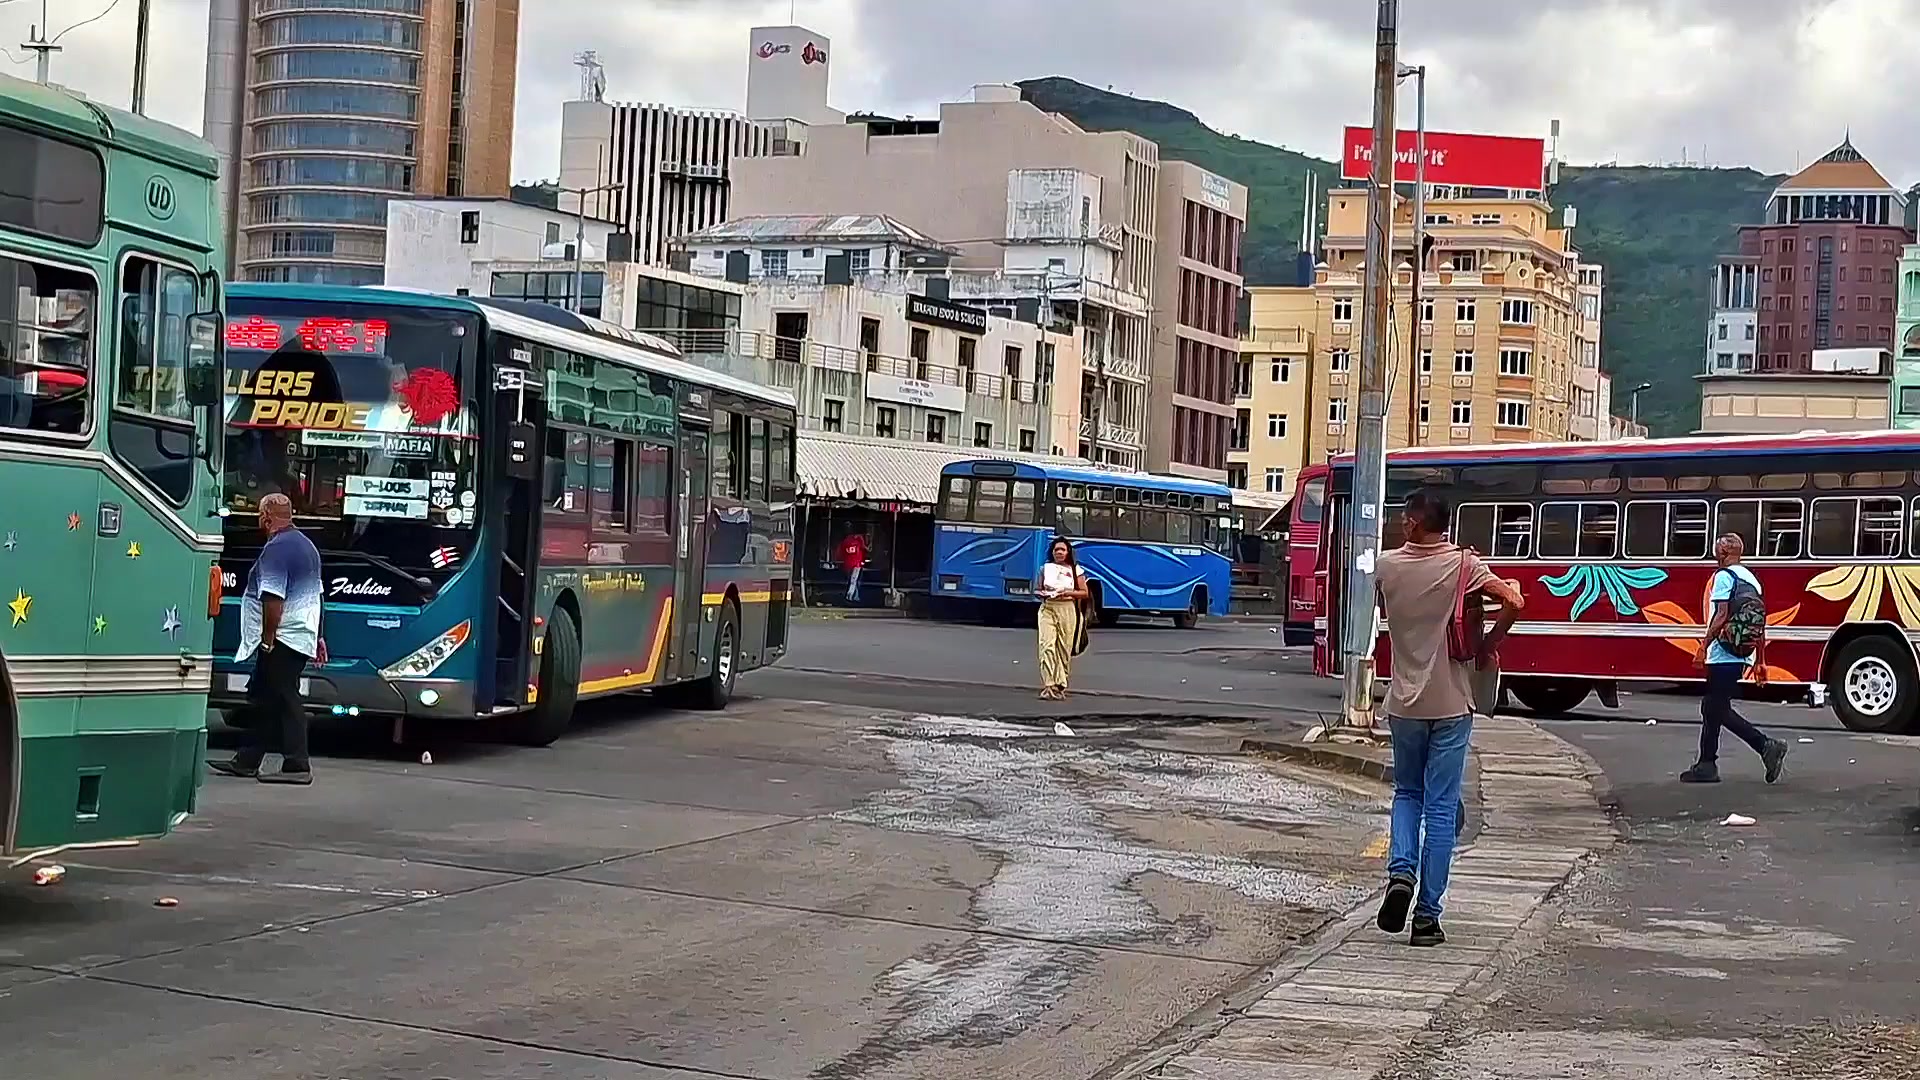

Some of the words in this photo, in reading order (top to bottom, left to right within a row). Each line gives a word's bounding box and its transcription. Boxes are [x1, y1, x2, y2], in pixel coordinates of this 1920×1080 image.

[1431, 148, 1444, 166] it
[148, 183, 170, 210] UD
[249, 400, 372, 429] PRIDE
[387, 437, 432, 453] MAFIA
[329, 577, 392, 597] Fashion
